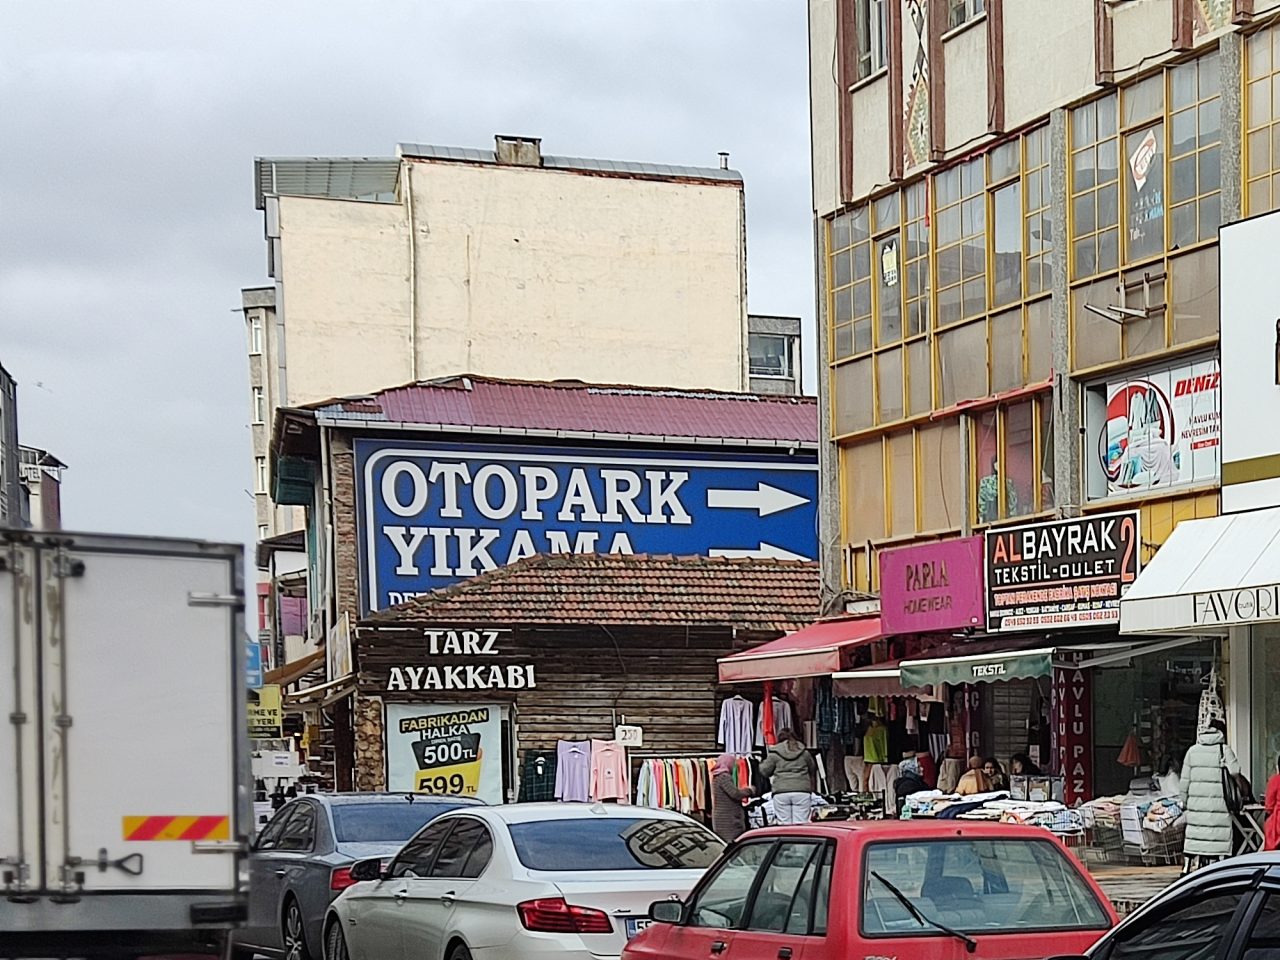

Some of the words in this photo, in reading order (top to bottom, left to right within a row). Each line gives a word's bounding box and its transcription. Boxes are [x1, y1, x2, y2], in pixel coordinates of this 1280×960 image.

[381, 460, 692, 524] OTOPARK
[993, 519, 1117, 564] ALBAYRAK
[1120, 516, 1136, 583] 2
[904, 596, 952, 615] HOMEWEAR
[424, 631, 499, 655] TARZ
[387, 665, 536, 691] AYAKKABI
[401, 710, 488, 731] FABRİKADAN
[422, 724, 469, 740] HALKA
[424, 743, 462, 764] 500
[463, 749, 476, 759] TL
[418, 774, 464, 794] 599
[466, 785, 477, 793] TL
